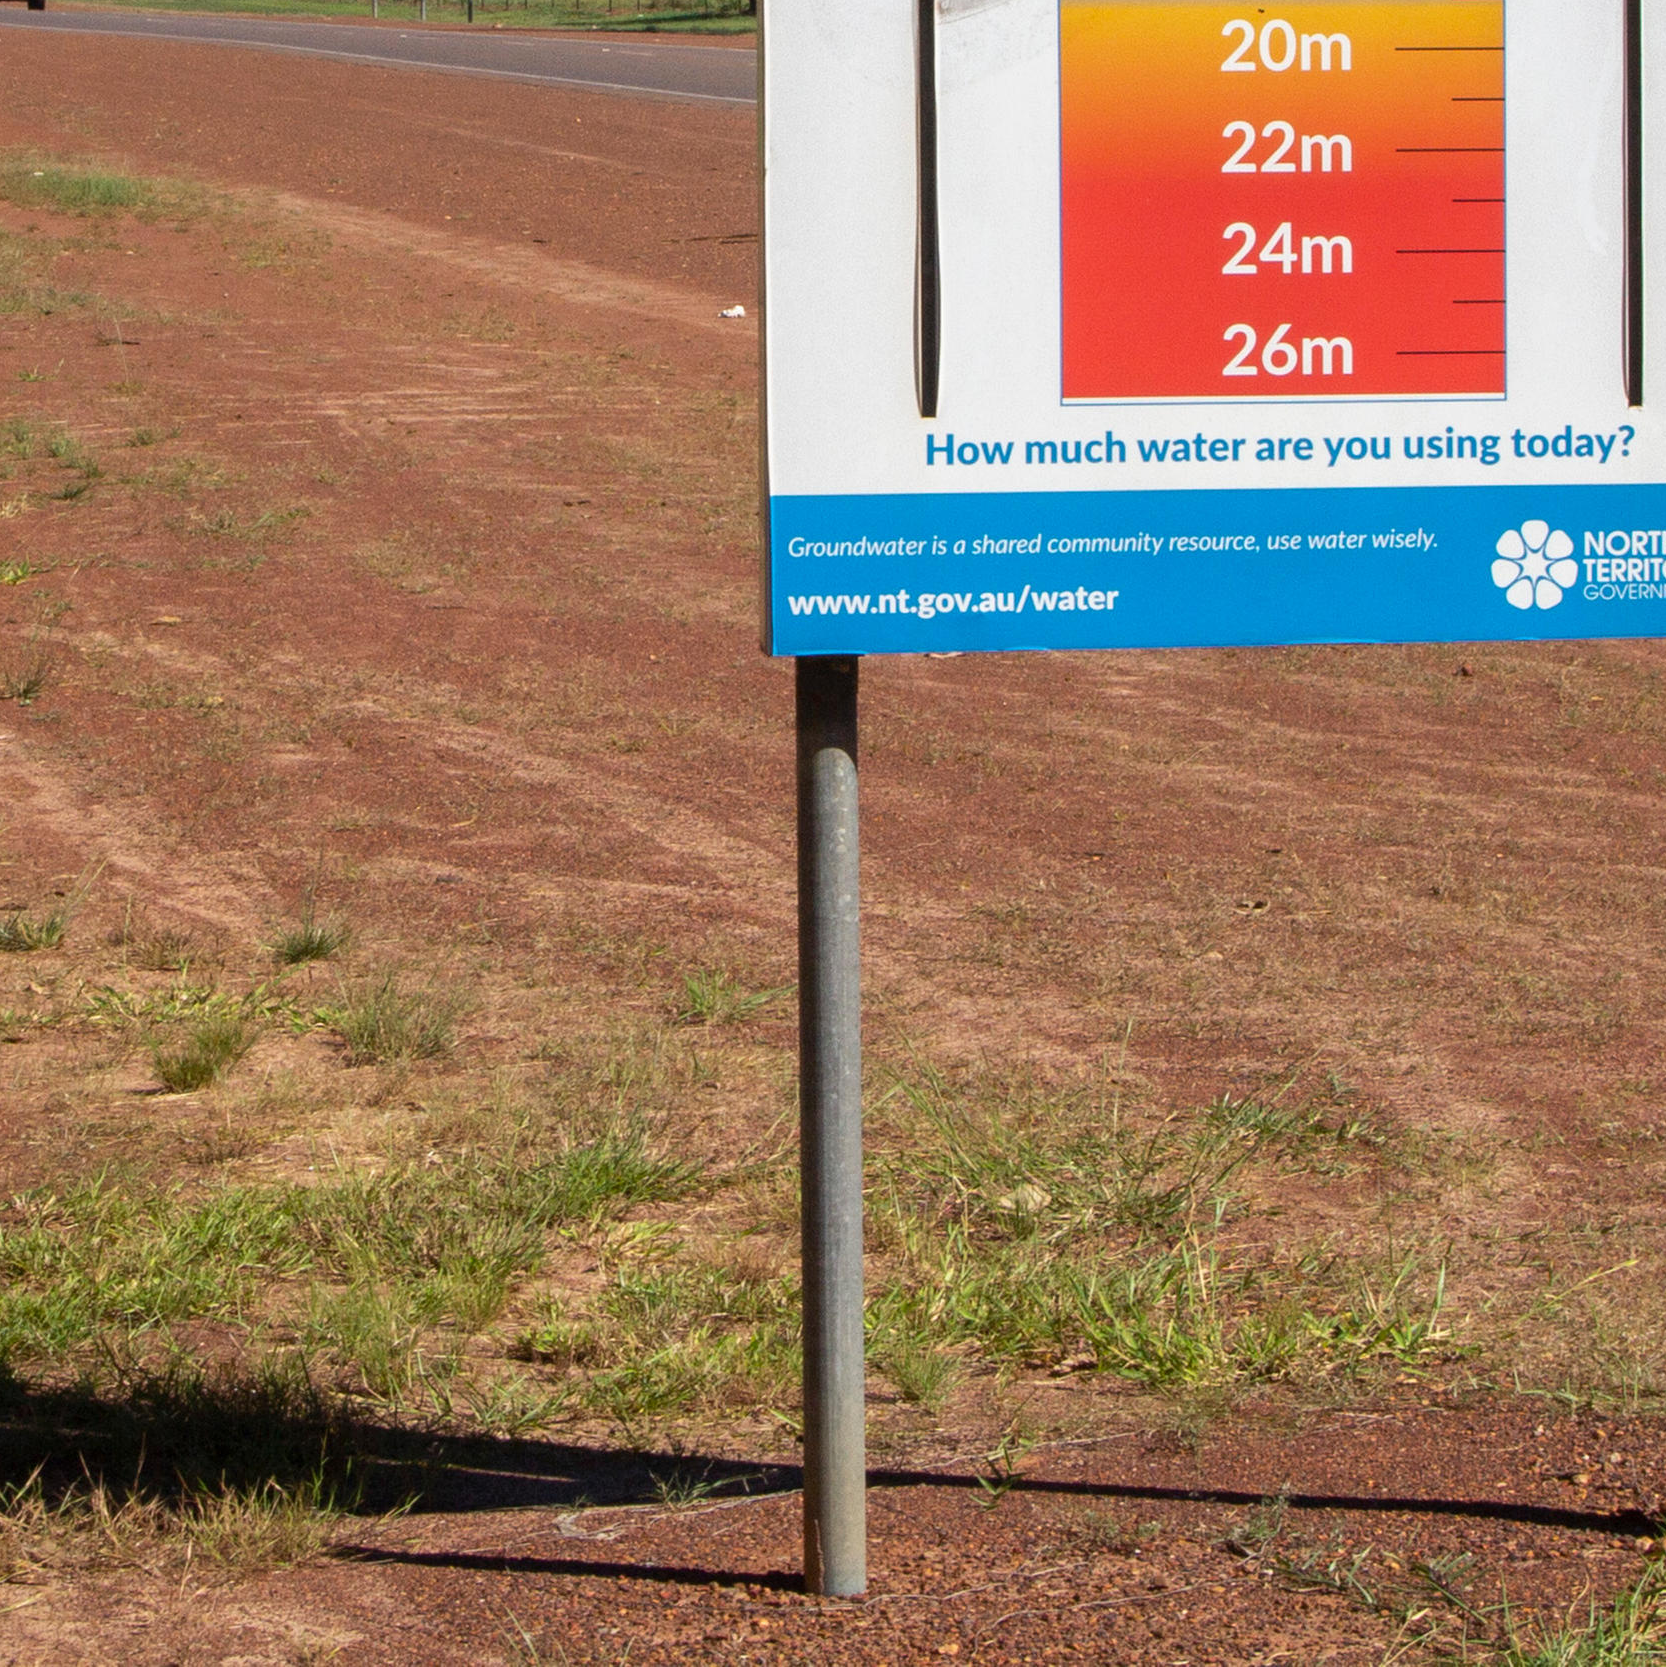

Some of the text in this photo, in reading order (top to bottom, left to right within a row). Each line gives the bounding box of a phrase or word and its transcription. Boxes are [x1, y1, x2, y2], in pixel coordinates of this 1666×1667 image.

[1220, 19, 1352, 72] 20m
[1221, 120, 1353, 173] 22m
[1221, 222, 1353, 275] 24m
[1222, 323, 1353, 376] 26m
[926, 424, 1636, 467] How much water are you using today?
[788, 528, 1438, 558] Groundwater is a shared community resource, use water wisely.
[787, 584, 1119, 619] www.nt.gov.au/water
